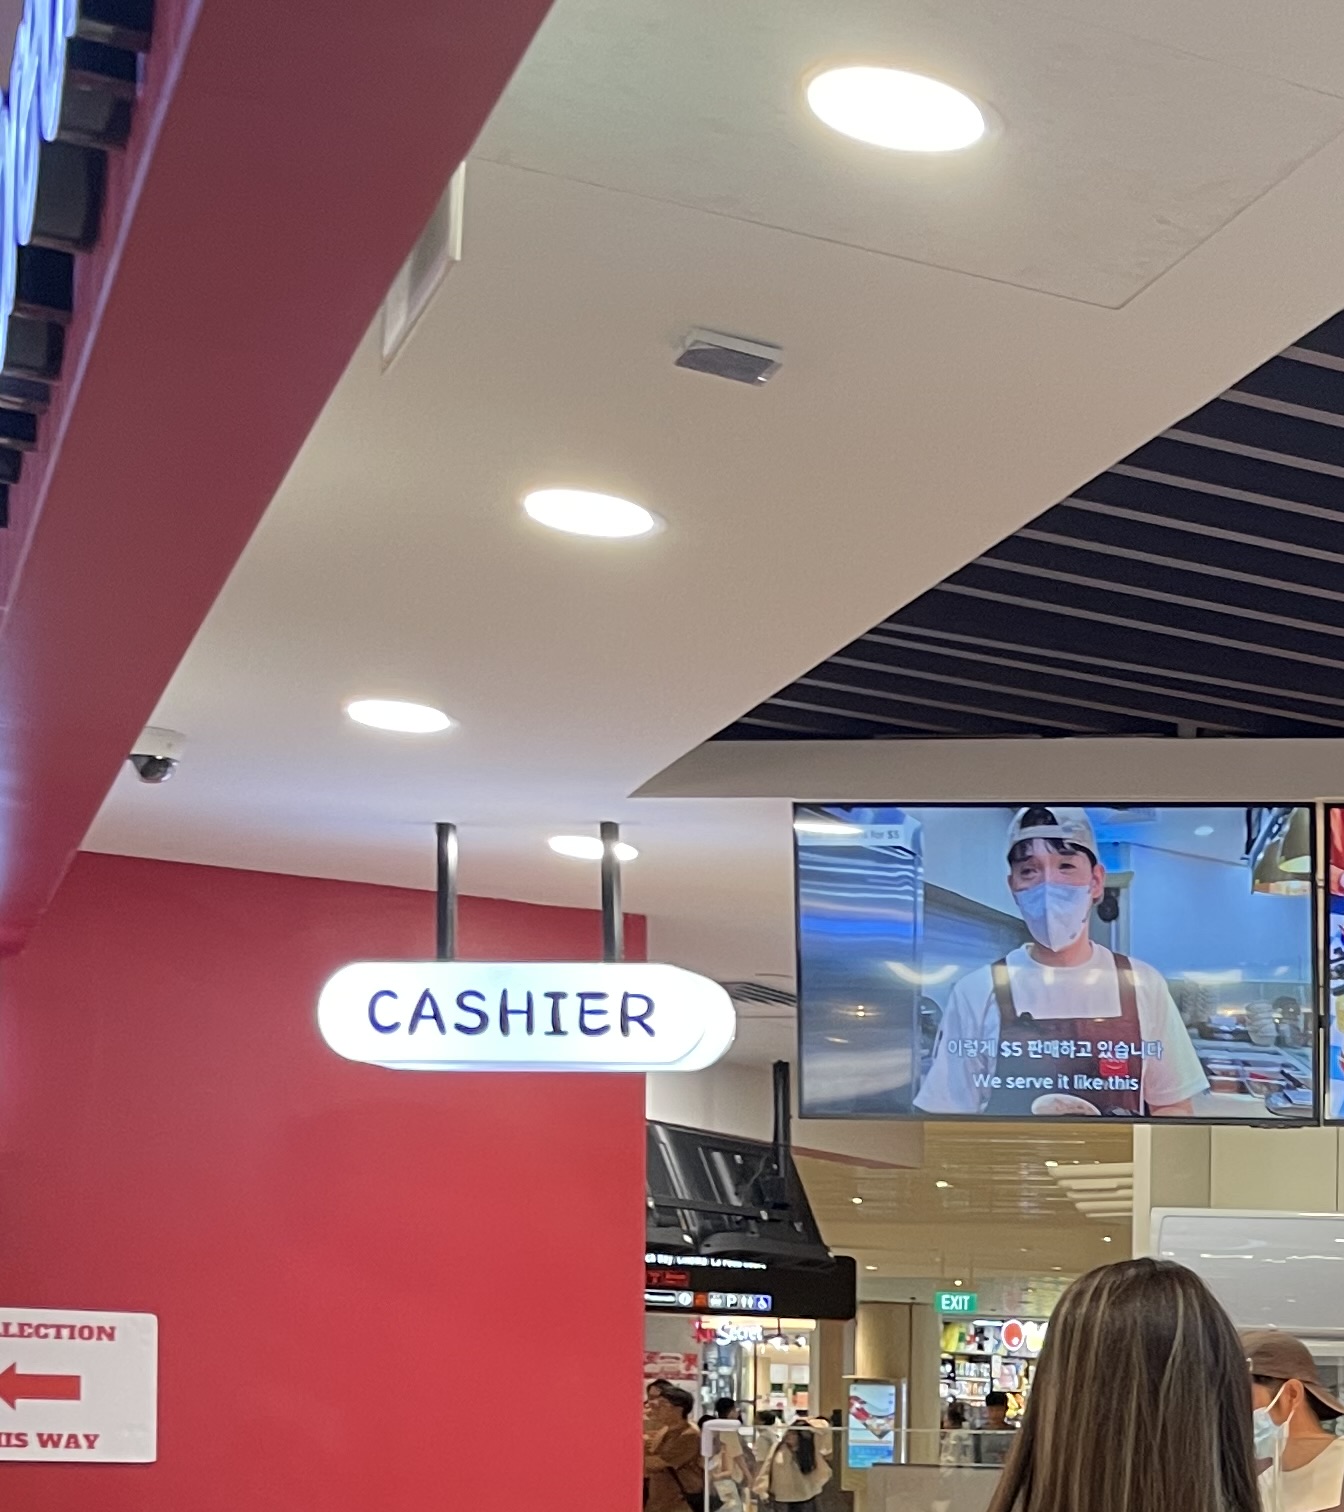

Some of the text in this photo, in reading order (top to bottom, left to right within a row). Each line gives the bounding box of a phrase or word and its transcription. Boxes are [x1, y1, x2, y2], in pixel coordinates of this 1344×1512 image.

[368, 987, 656, 1037] CASHIER
[947, 1039, 996, 1058] 이렇게
[1001, 1041, 1022, 1057] $5
[1097, 1039, 1163, 1059] 있습니다
[974, 1074, 1139, 1090] We serve it like this
[941, 1294, 970, 1311] EXIT
[0, 1322, 116, 1341] LECTION
[37, 1432, 100, 1449] WAY
